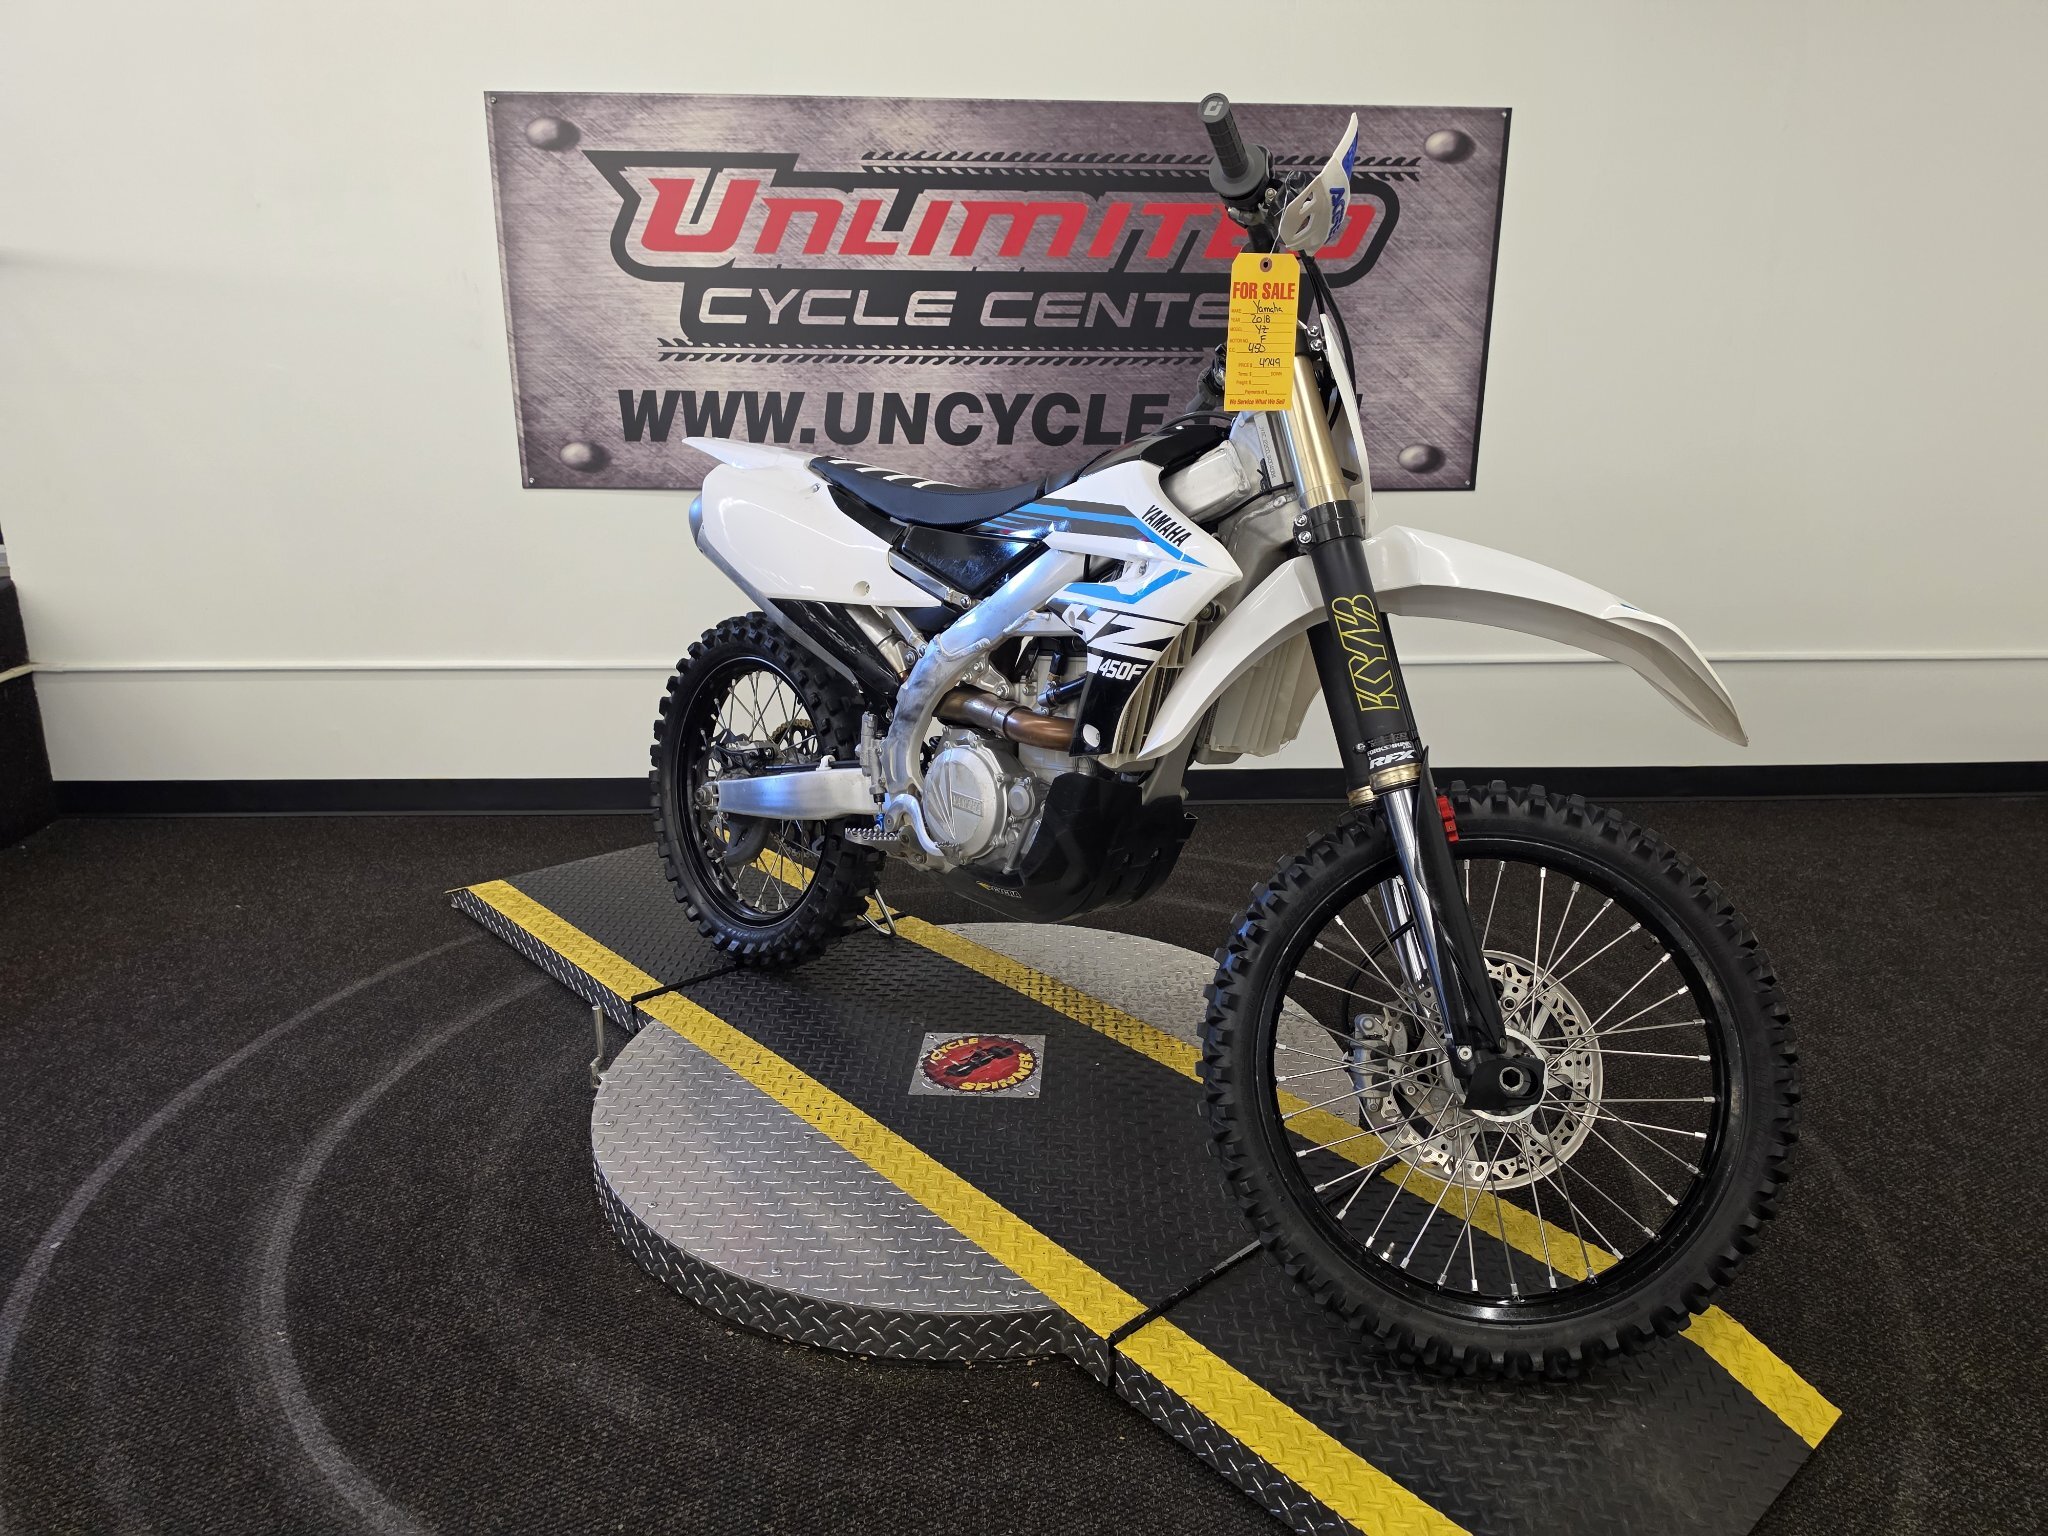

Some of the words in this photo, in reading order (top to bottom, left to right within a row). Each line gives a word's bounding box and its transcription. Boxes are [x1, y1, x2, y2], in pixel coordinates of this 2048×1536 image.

[1232, 281, 1258, 300] FOR
[1262, 281, 1295, 300] SALE
[699, 288, 957, 327] CYCLE
[979, 290, 1232, 329] CENTE
[1253, 300, 1283, 314] Yamaha
[1248, 342, 1267, 354] 450
[1260, 334, 1267, 344] F
[618, 388, 1224, 447] WWW.UNCYCLE
[1141, 504, 1193, 548] YAMAHA
[1332, 594, 1400, 712] KYB
[1098, 658, 1148, 681] 450F
[1369, 750, 1415, 770] RFX
[930, 1037, 979, 1061] CYCLE
[958, 1052, 1034, 1091] SPINNER
